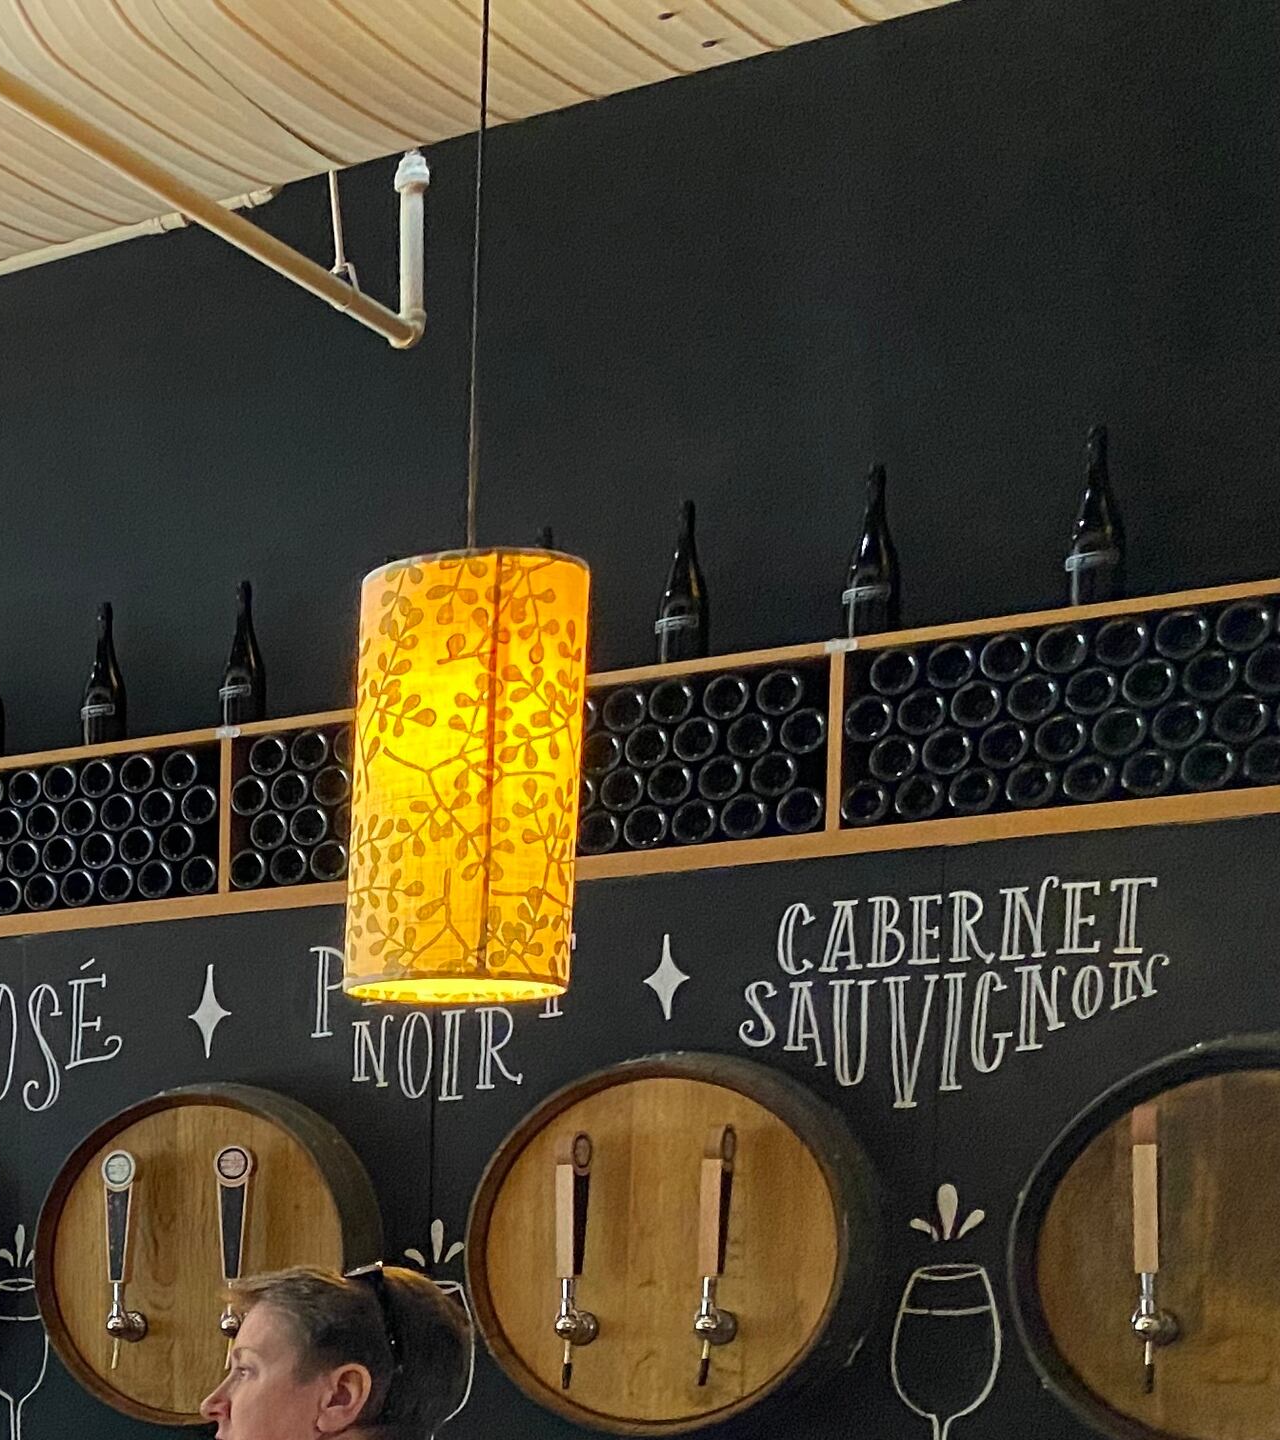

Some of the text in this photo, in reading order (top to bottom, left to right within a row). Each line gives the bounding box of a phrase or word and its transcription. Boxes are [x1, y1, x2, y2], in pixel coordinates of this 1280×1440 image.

[777, 876, 1158, 975] CABERNET
[352, 1007, 523, 1101] NOIR
[738, 954, 1170, 1109] SAUVIGNON
